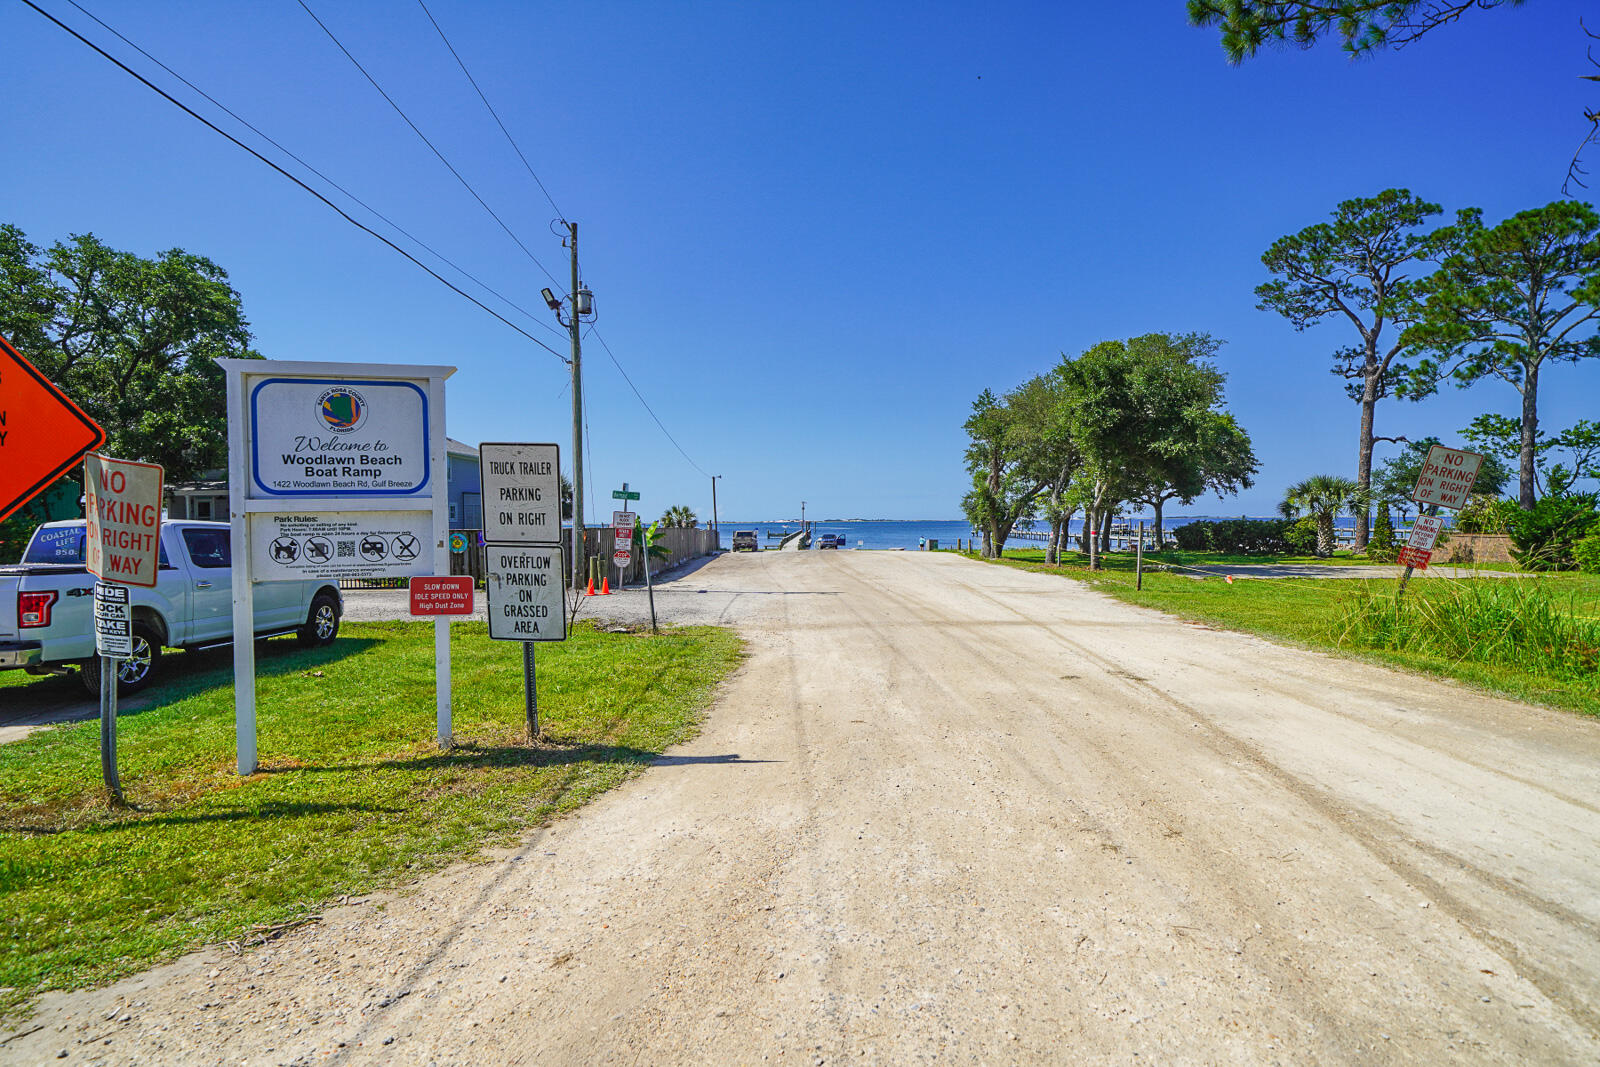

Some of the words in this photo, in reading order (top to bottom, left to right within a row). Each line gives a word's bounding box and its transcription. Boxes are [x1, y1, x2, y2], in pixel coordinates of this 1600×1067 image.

[294, 436, 371, 452] Welcome
[373, 440, 389, 452] to
[282, 454, 355, 465] Woodlawn
[360, 454, 403, 465] Beach
[1444, 453, 1464, 467] NO
[305, 466, 338, 477] Boat
[342, 466, 382, 479] Ramp
[489, 461, 516, 475] TRUCK
[519, 461, 552, 476] TRAILER
[1425, 464, 1474, 483] PARKING
[100, 469, 126, 494] NO
[273, 480, 291, 488] 1422
[293, 480, 331, 488] Woodlawn
[332, 480, 356, 488] Beach
[357, 480, 370, 489] Rd,
[371, 480, 387, 488] Gulf
[387, 480, 413, 488] Breeze
[1420, 477, 1434, 487] ON
[1440, 481, 1471, 494] RIGHT
[500, 488, 542, 502] PARKING
[1420, 488, 1434, 498] OF
[1440, 493, 1459, 505] WAY
[89, 493, 155, 527] PARKING
[500, 511, 513, 525] ON
[518, 512, 546, 526] RIGHT
[40, 528, 80, 543] COASTAL
[55, 537, 75, 547] LIFE
[102, 528, 154, 552] RIGHT
[109, 554, 142, 575] WAY
[501, 556, 551, 569] OVERFLOW
[506, 573, 547, 586] PARKING
[519, 590, 532, 602] ON
[97, 602, 125, 613] LOCK
[504, 605, 548, 618] GRASSED
[514, 621, 540, 633] AREA
